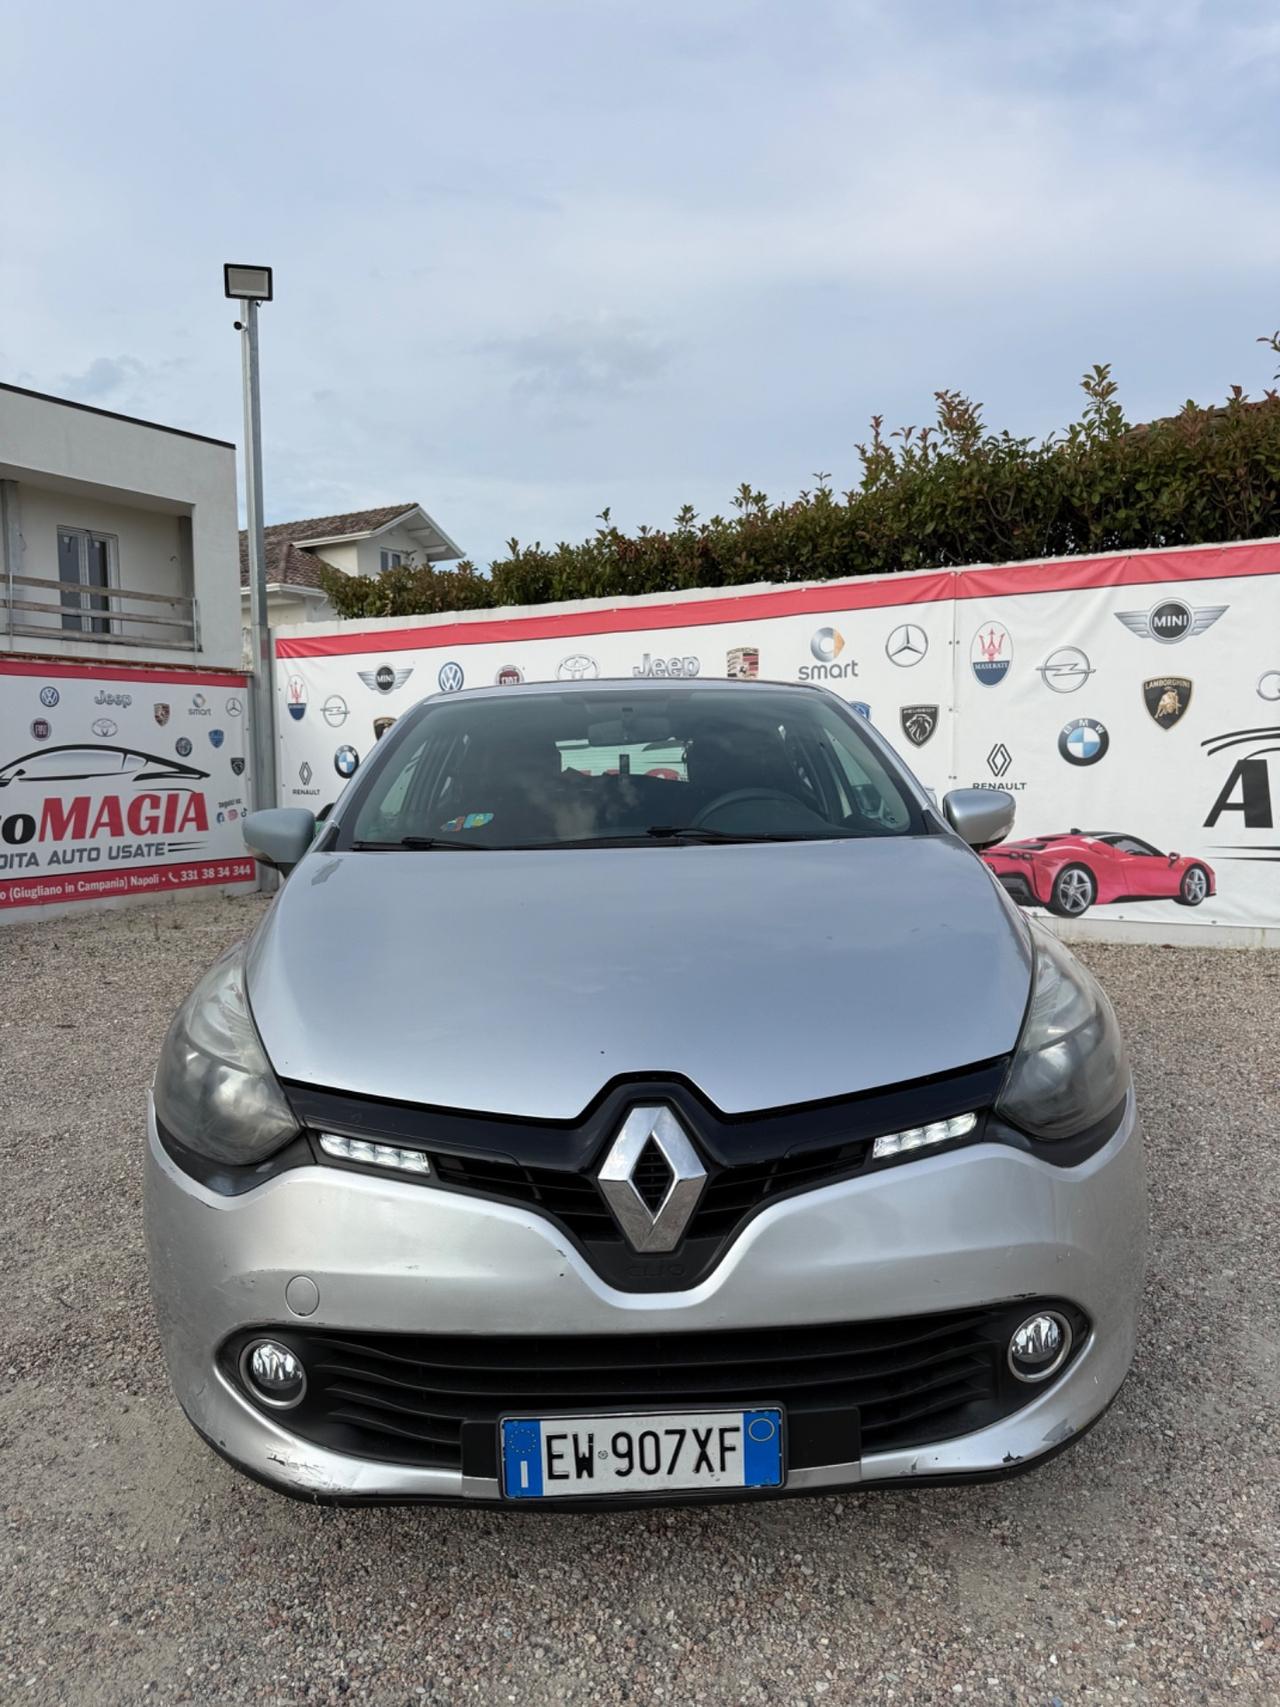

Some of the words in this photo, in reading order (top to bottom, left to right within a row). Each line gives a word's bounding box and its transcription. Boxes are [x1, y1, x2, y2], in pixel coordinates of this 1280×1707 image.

[1153, 614, 1187, 628] MINI
[632, 653, 701, 678] Jeep
[798, 660, 859, 681] smart
[972, 782, 1028, 791] RENAULT
[0, 792, 210, 846] oMAGIA
[47, 847, 101, 866] AUTO
[108, 842, 166, 861] USATE
[65, 883, 75, 893] in
[77, 876, 128, 891] Campania)
[130, 873, 160, 888] Napoli
[180, 870, 199, 881] 331
[202, 868, 215, 879] 38
[217, 866, 230, 878] 34
[233, 865, 251, 876] 344
[545, 1432, 595, 1480] EW
[611, 1426, 741, 1478] 907XF
